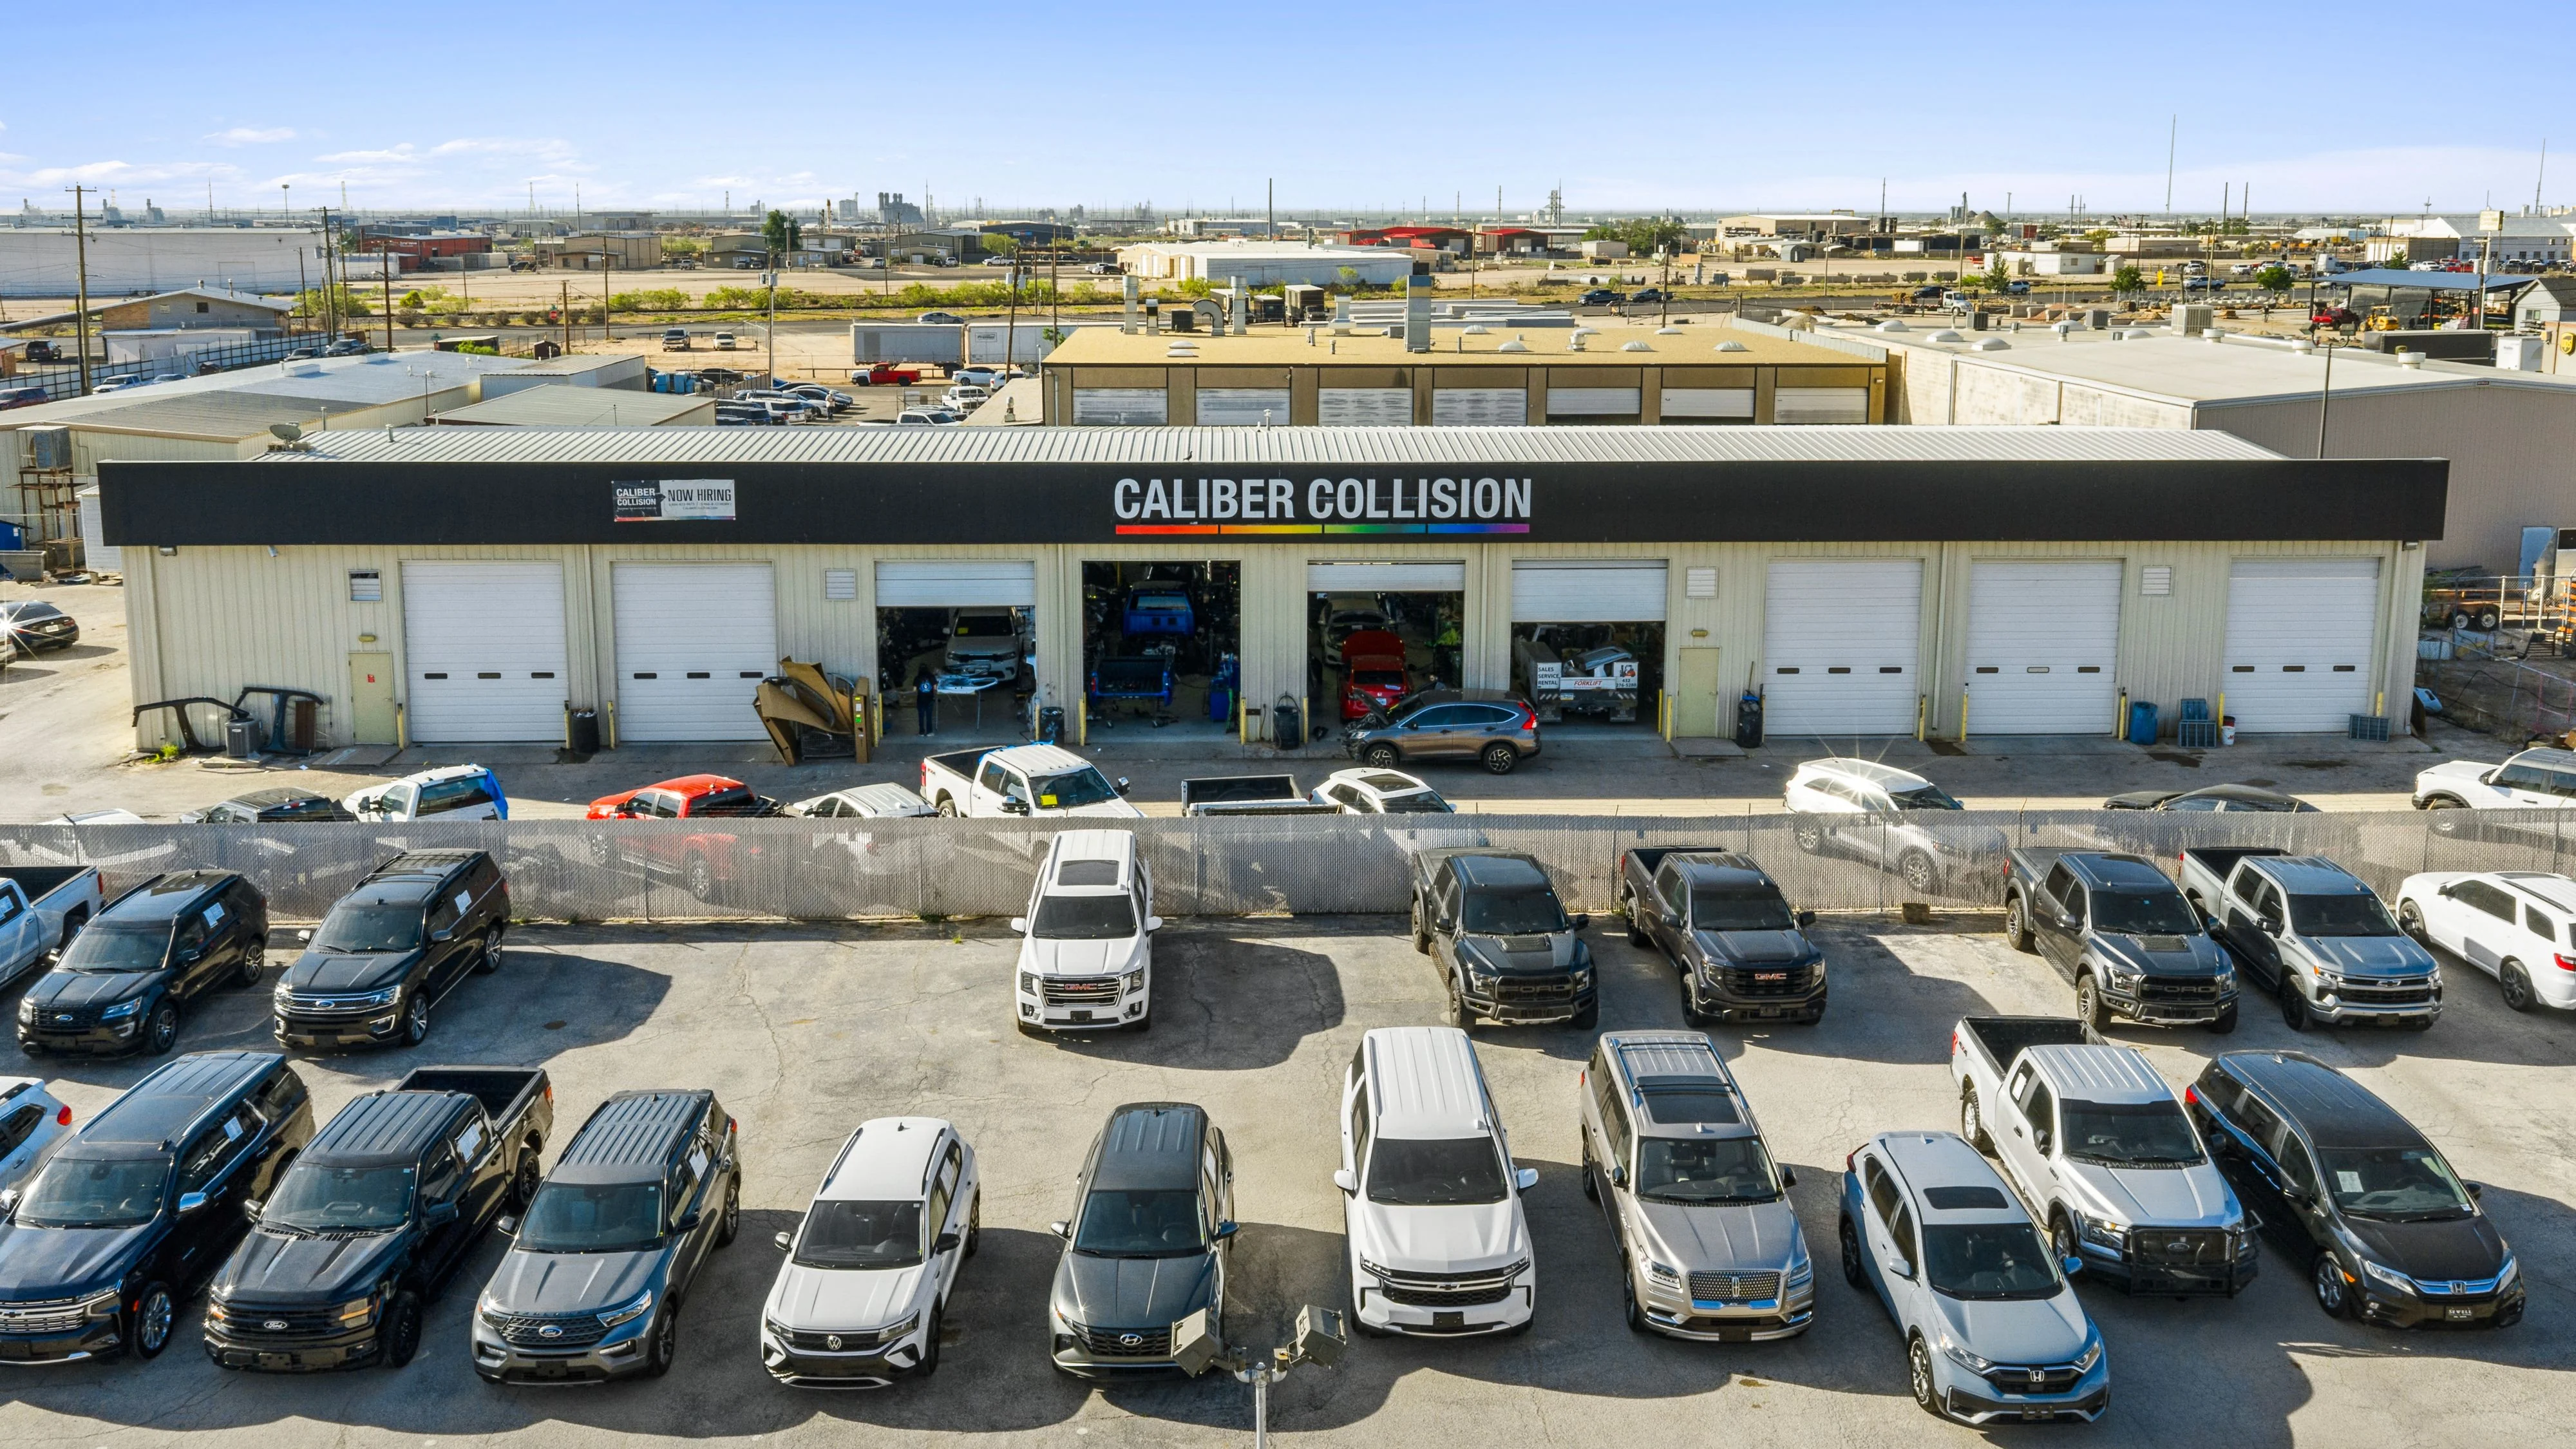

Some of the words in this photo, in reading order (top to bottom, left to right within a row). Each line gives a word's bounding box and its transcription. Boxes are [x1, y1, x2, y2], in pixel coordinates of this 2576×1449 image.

[616, 488, 656, 497] CALIBER
[668, 489, 693, 502] NOW
[697, 489, 732, 501] HIRING
[1113, 478, 1295, 520] CALIBER
[1307, 478, 1531, 520] COLLISION
